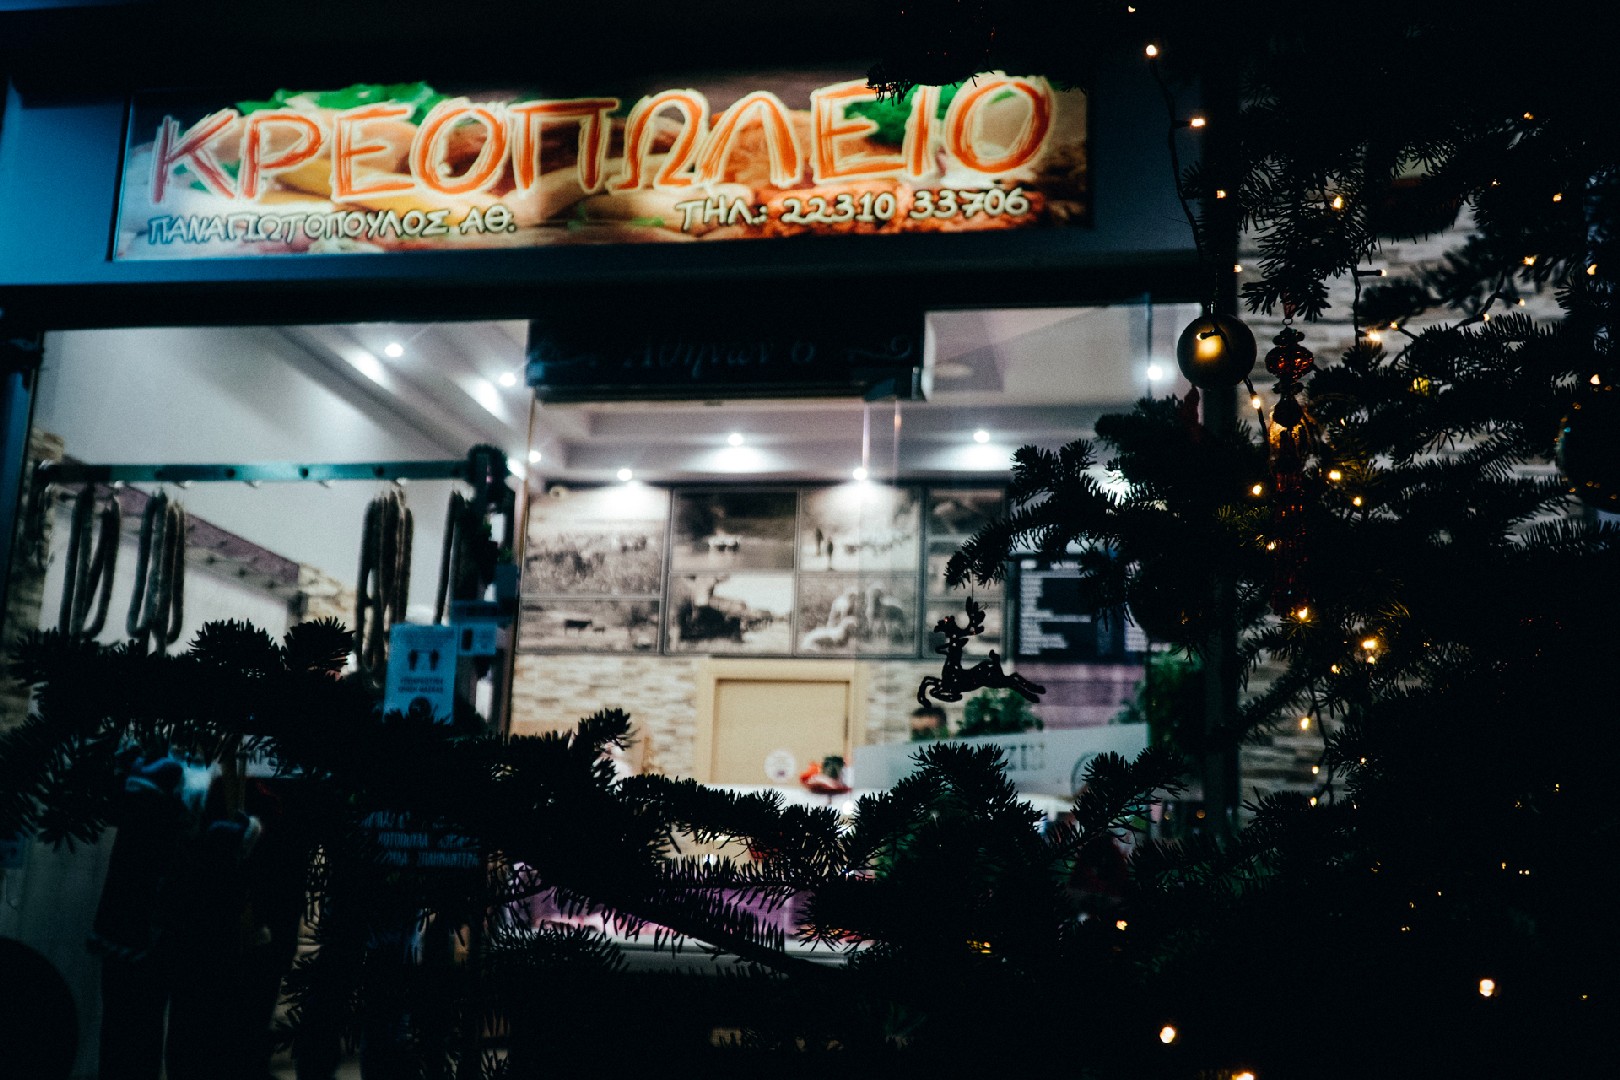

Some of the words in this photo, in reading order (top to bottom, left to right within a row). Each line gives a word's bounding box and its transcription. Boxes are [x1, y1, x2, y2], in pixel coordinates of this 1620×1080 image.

[150, 71, 1057, 203] ΚΡΕΟΠΩΛΕΙΟ
[148, 209, 450, 245] ΠΑΝΑΓΙΩΤΟΠΟΥΛΟΣ
[459, 204, 517, 235] ΑΘ.
[780, 191, 896, 224] 22310
[909, 187, 1030, 219] 33706
